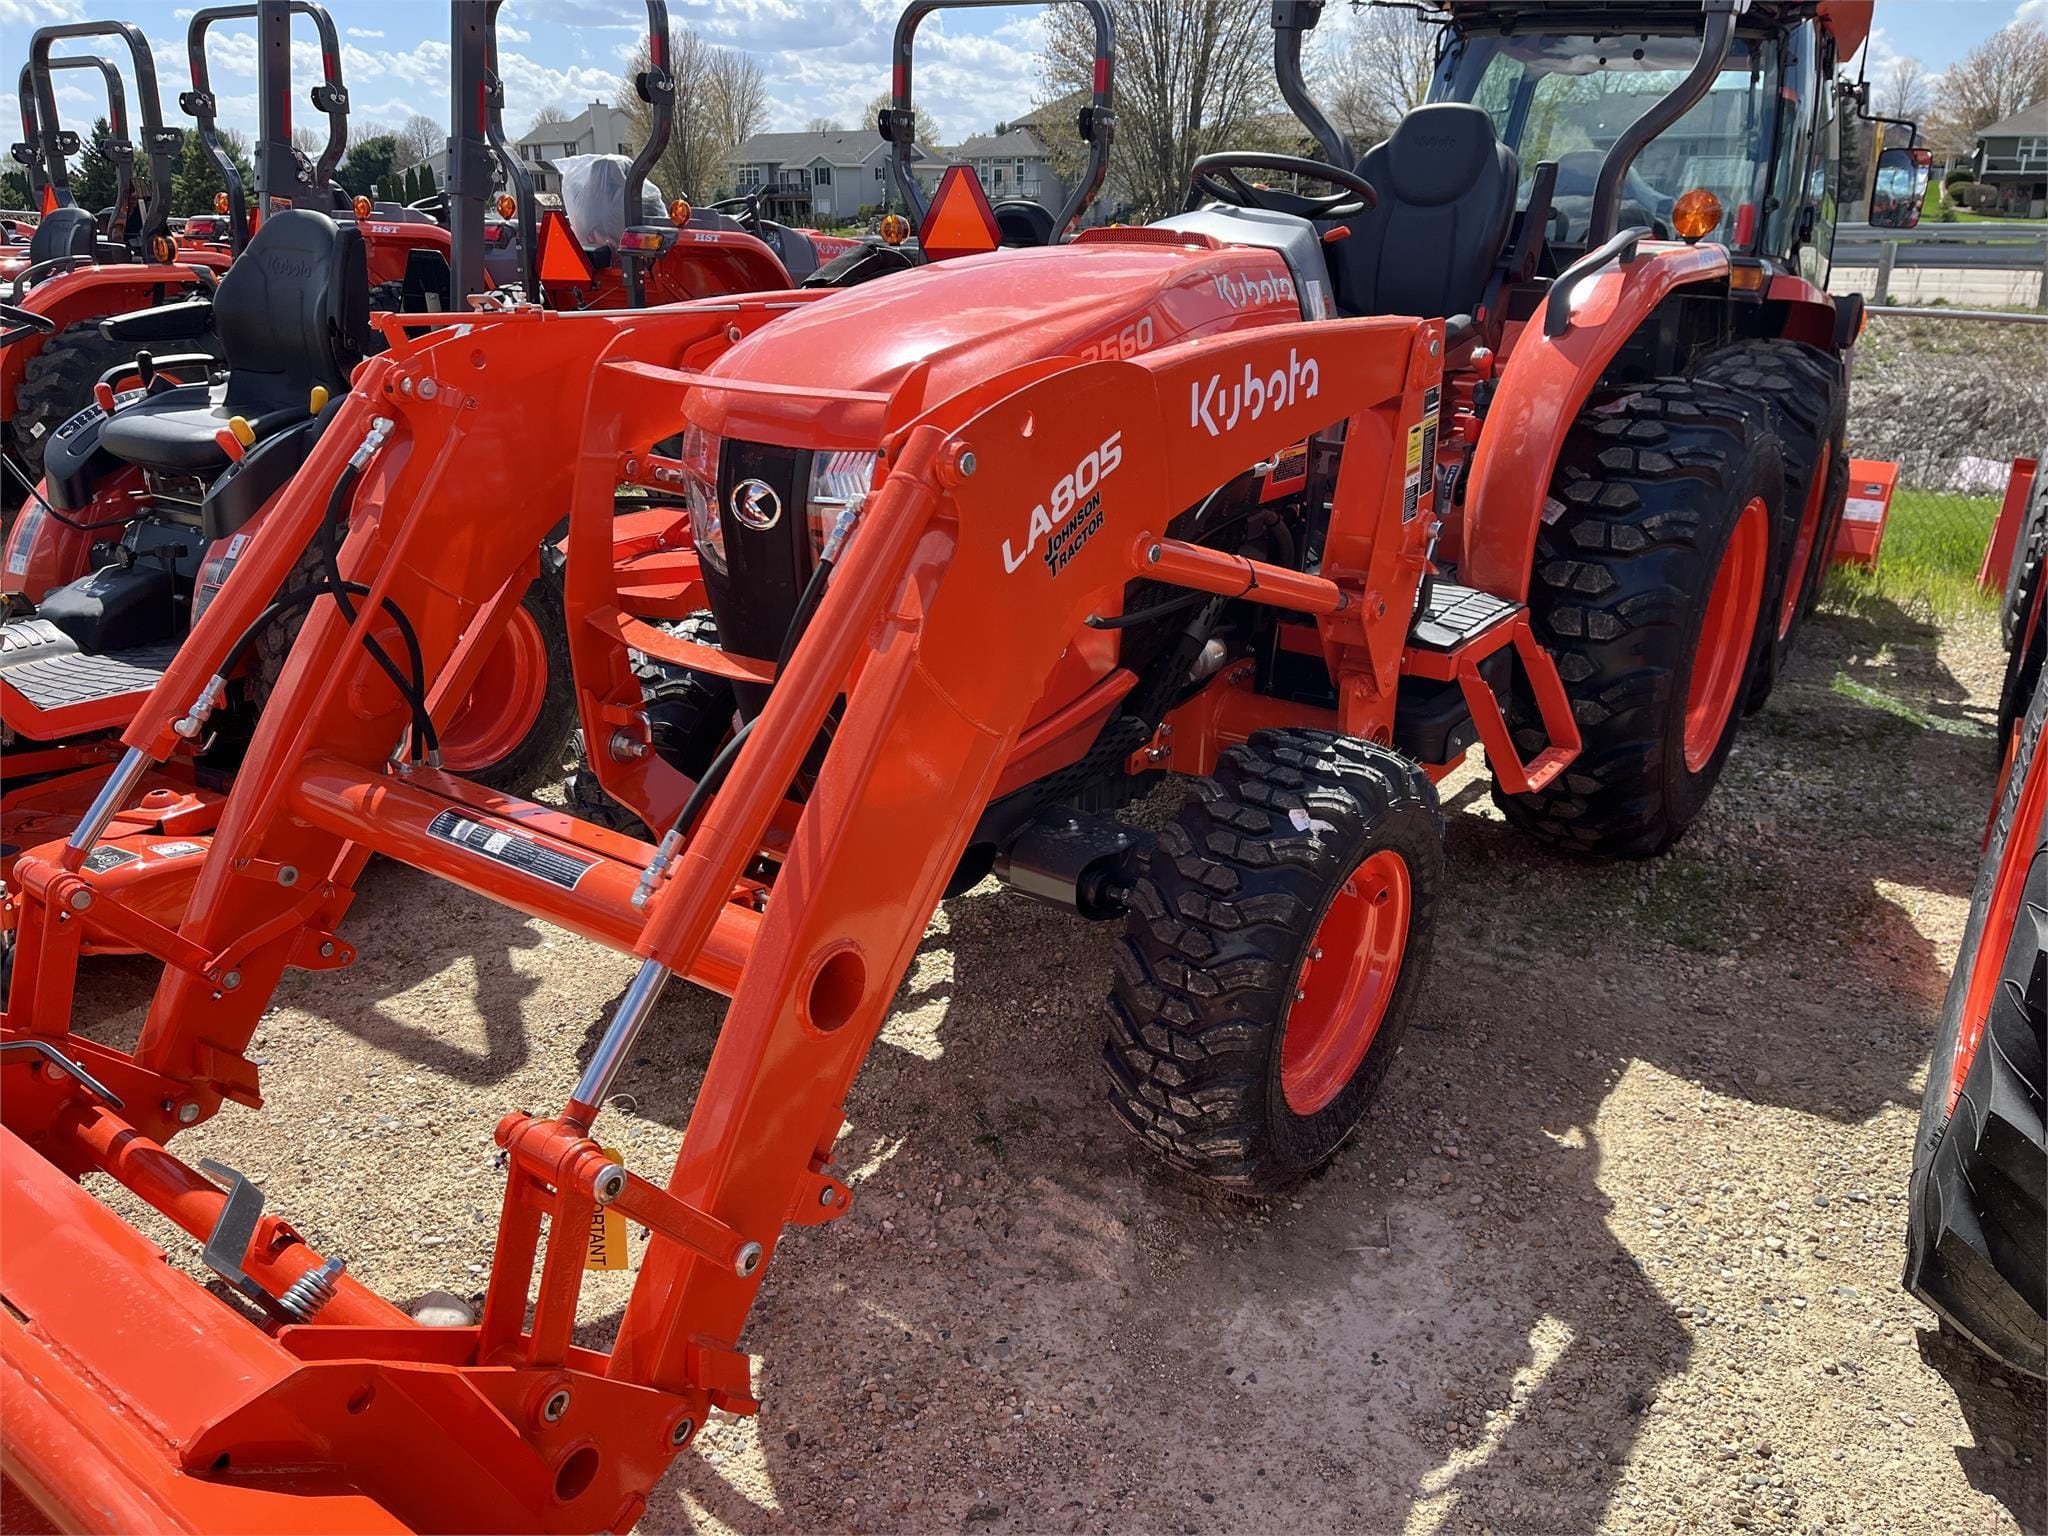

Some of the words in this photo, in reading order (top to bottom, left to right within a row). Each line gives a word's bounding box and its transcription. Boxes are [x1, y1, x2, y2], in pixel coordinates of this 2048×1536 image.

[371, 225, 400, 234] HST
[694, 233, 721, 242] HST
[1212, 270, 1296, 308] Kubota
[1191, 348, 1319, 437] Kubota
[1002, 430, 1122, 574] LA805
[1044, 491, 1100, 562] JOHNSON
[1048, 511, 1105, 578] TRACTOR
